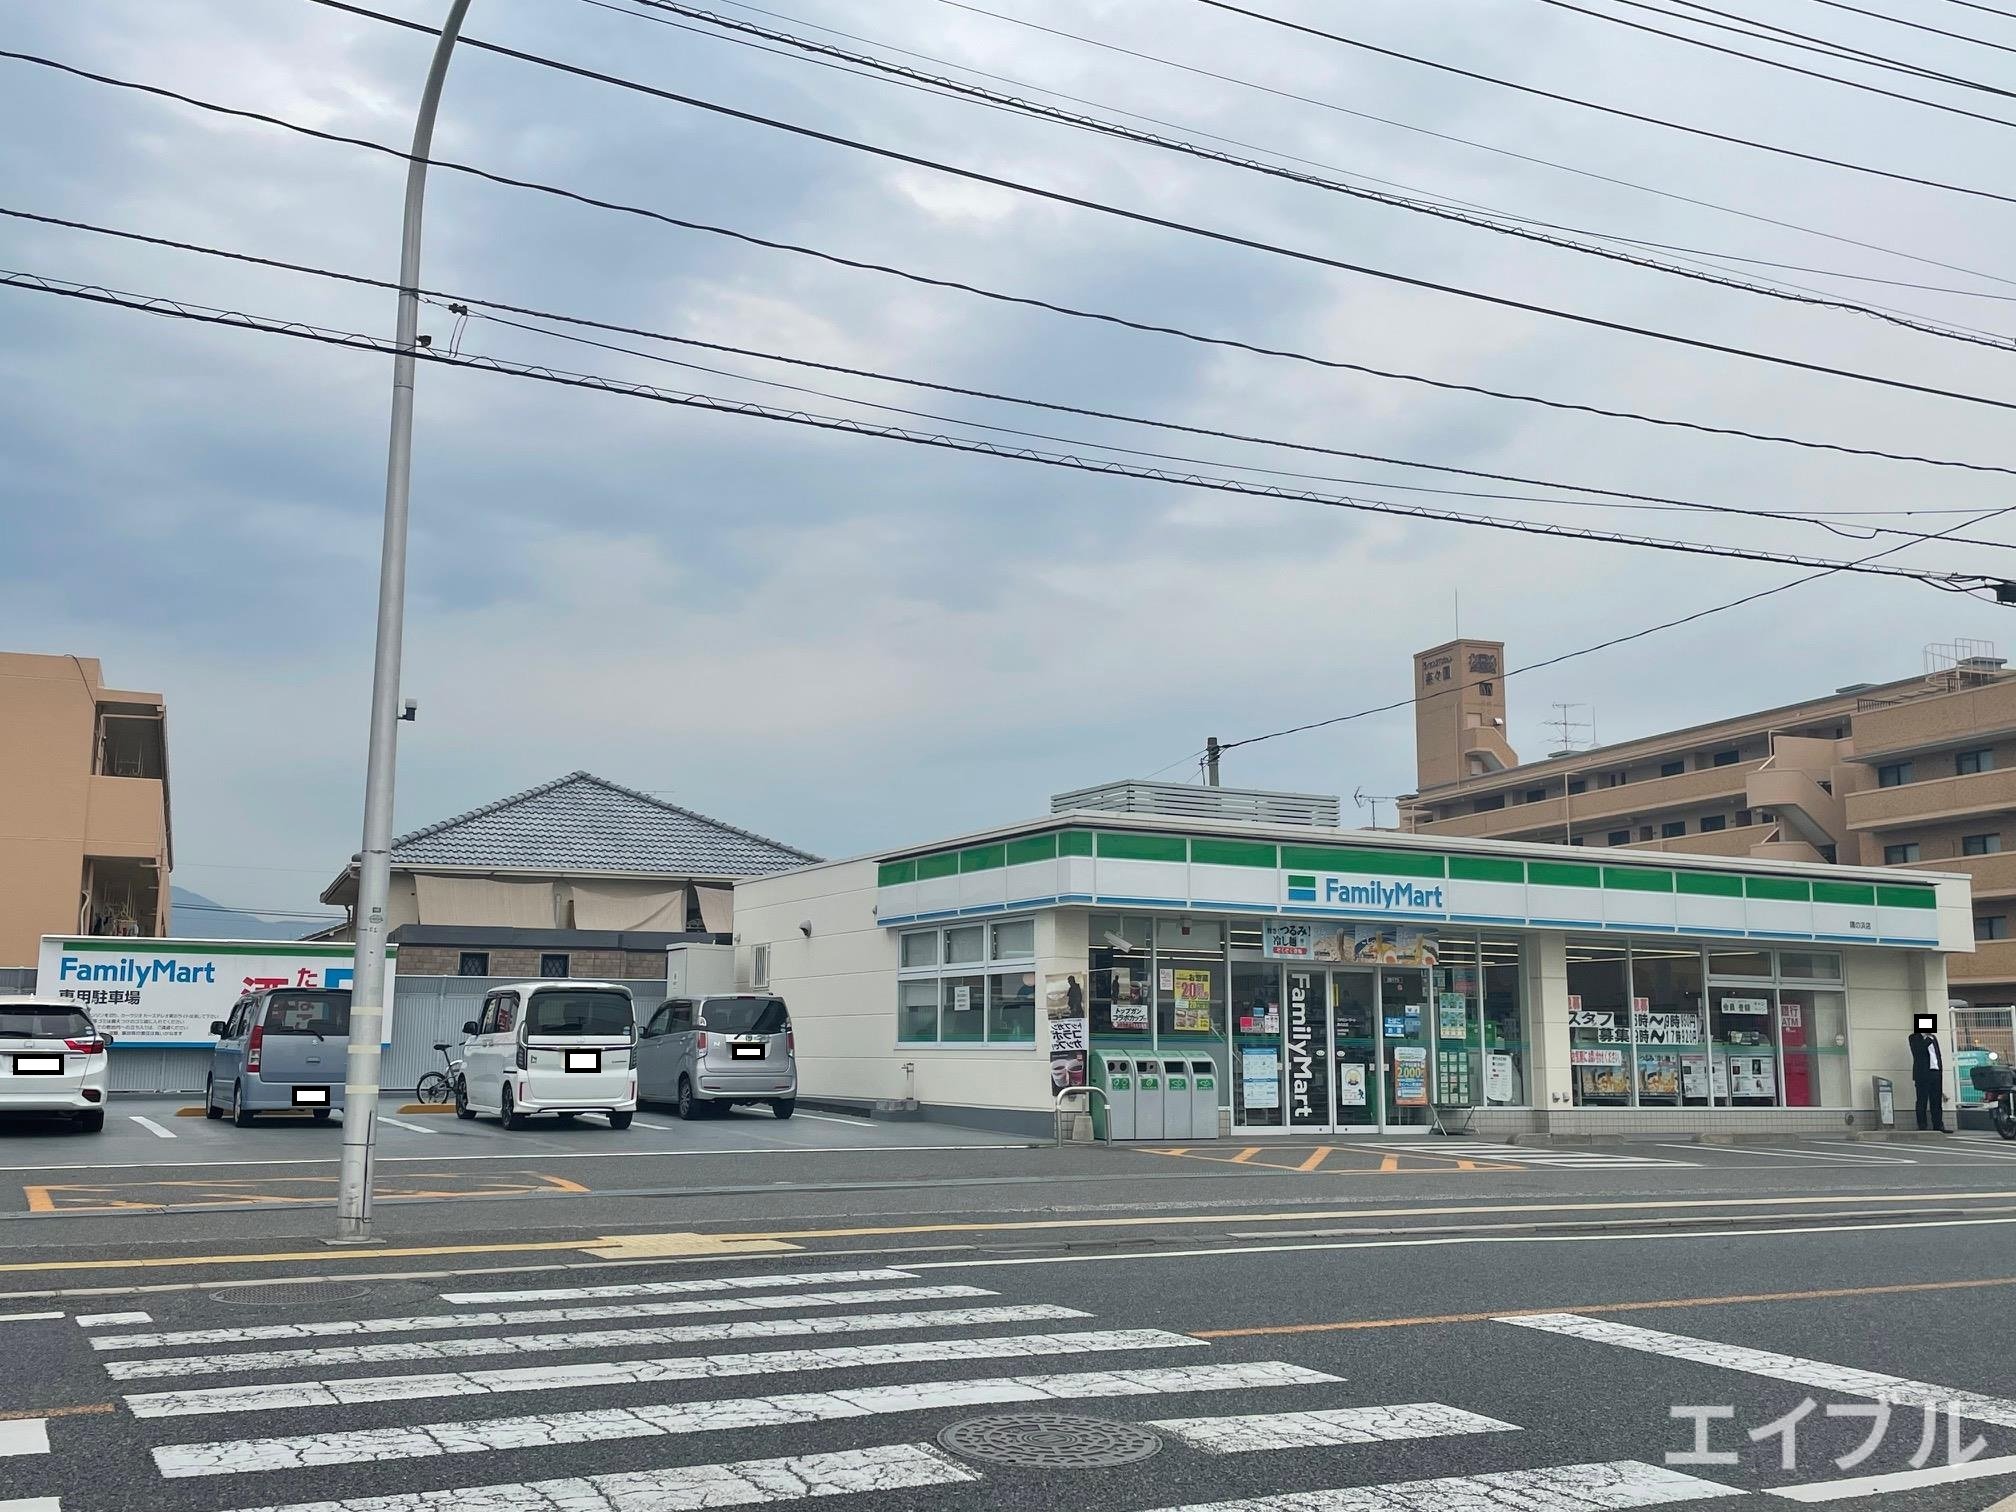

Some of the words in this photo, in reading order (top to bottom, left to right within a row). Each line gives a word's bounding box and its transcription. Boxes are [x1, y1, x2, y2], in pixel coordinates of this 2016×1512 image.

[1326, 878, 1442, 908] FamilyMart
[59, 957, 215, 988] FamilyMart
[58, 989, 141, 1005] 専用駐車場
[1288, 973, 1313, 1117] FamilyMart
[1599, 1028, 1630, 1043] 募集
